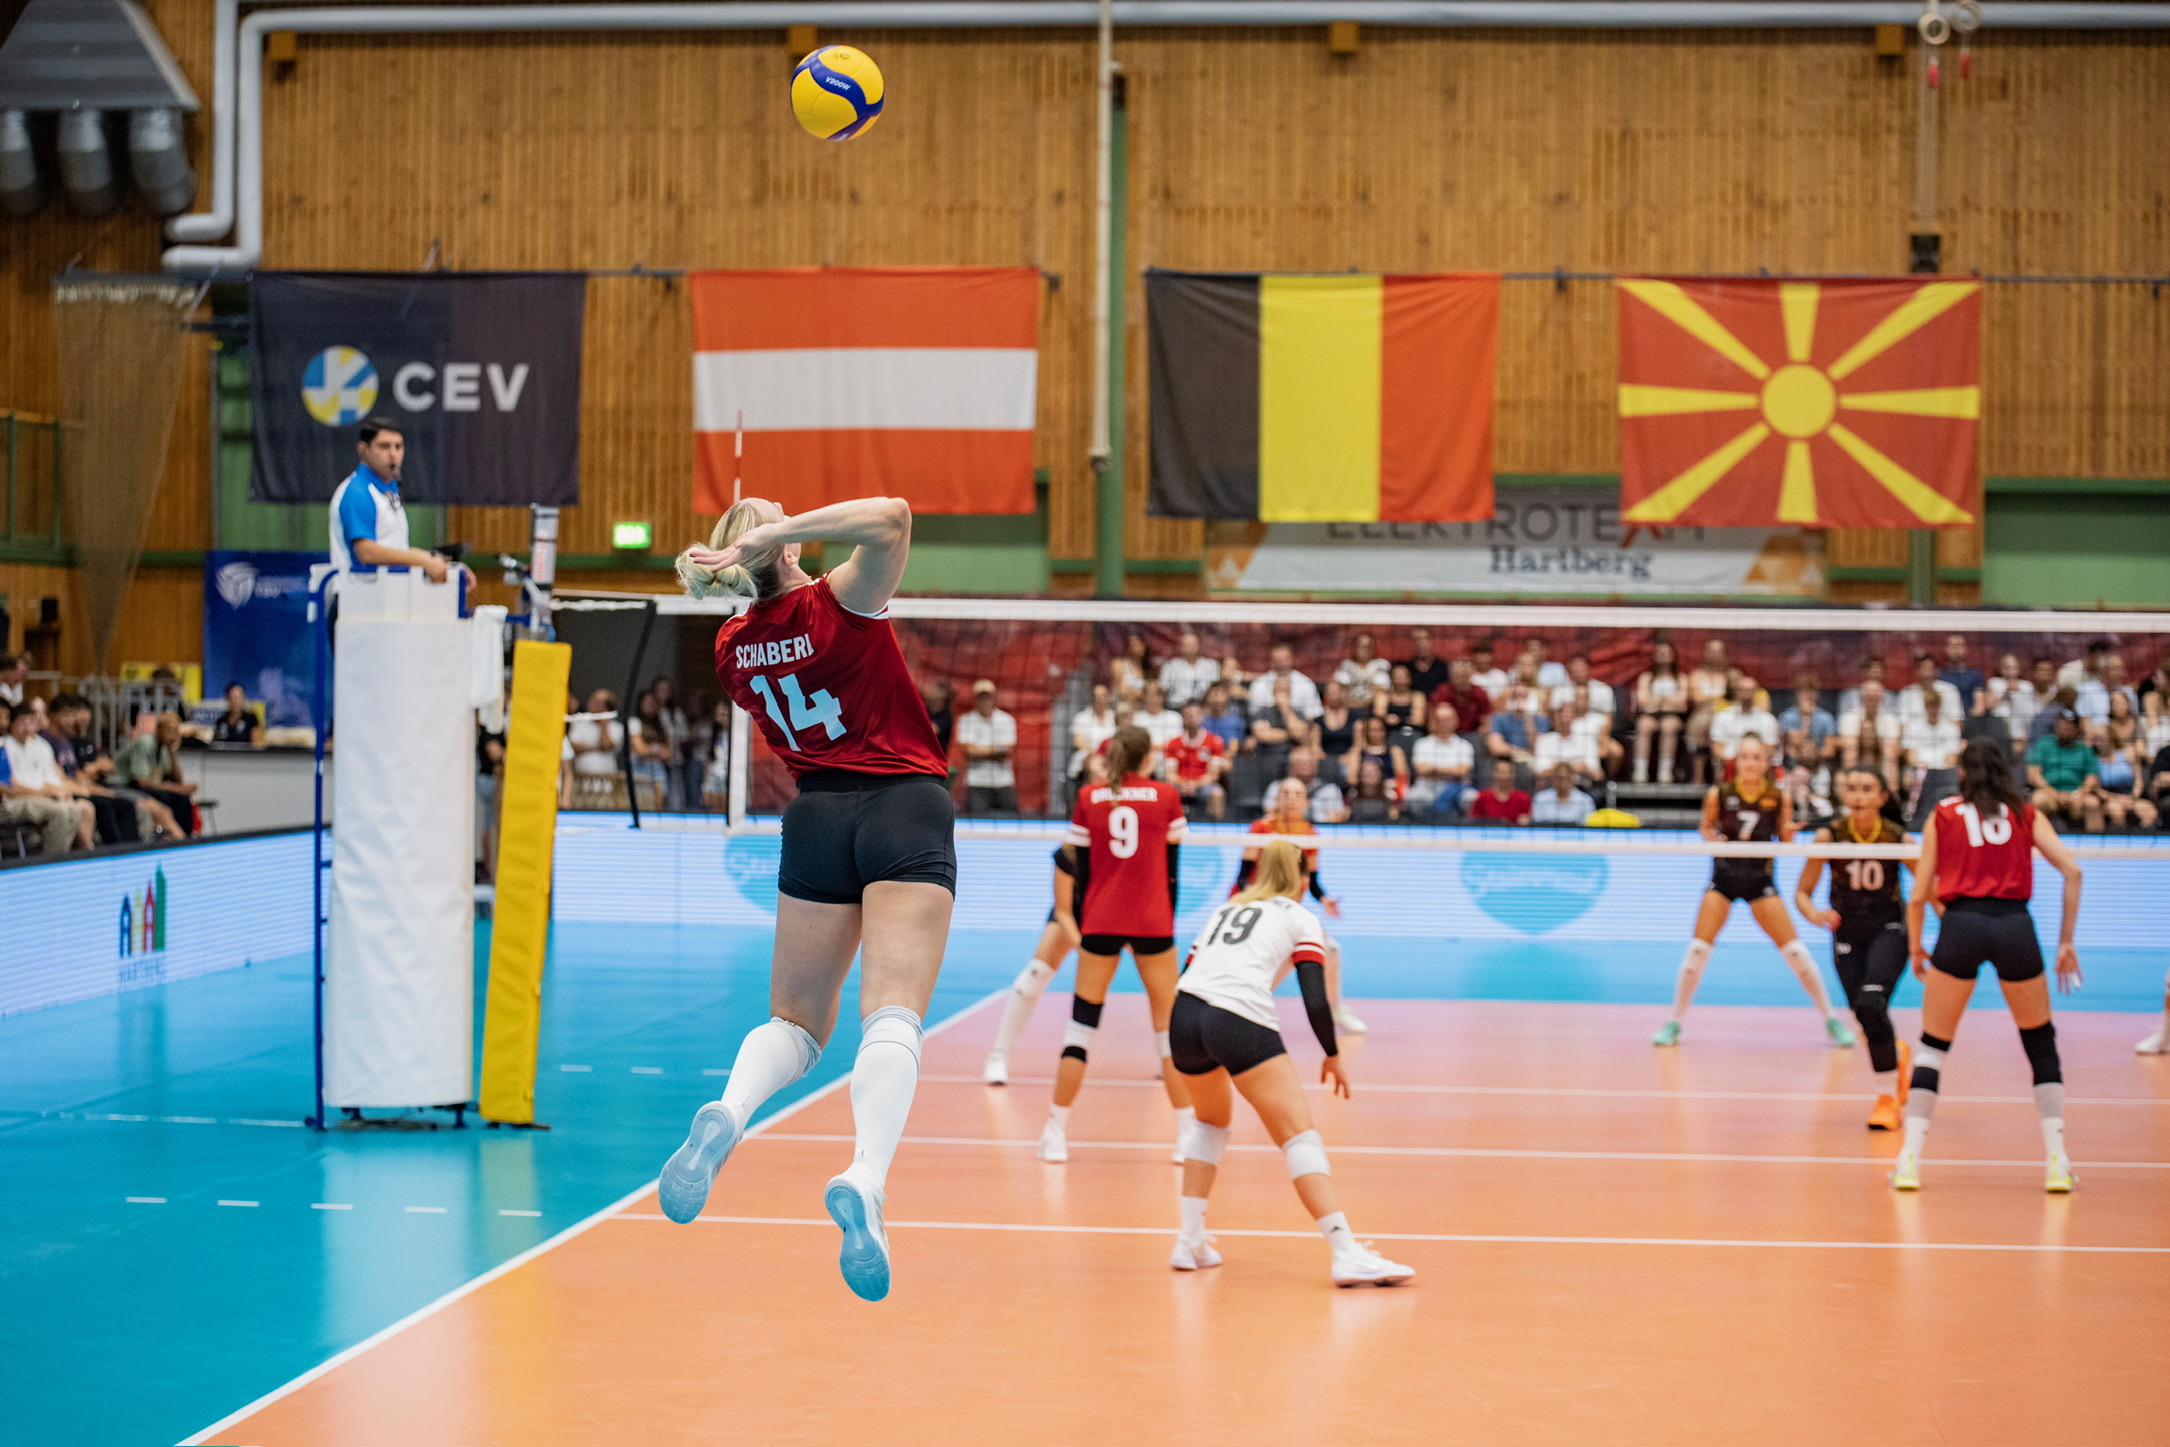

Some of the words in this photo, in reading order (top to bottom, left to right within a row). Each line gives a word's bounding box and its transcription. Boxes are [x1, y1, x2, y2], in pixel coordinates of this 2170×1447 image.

[825, 76, 851, 91] V200W
[392, 361, 530, 412] CEV
[1491, 544, 1654, 580] Hartberg
[749, 673, 847, 752] 14
[1108, 806, 1139, 859] 9
[1736, 810, 1760, 841] 7
[1846, 860, 1884, 890] 10
[1207, 907, 1262, 946] 19
